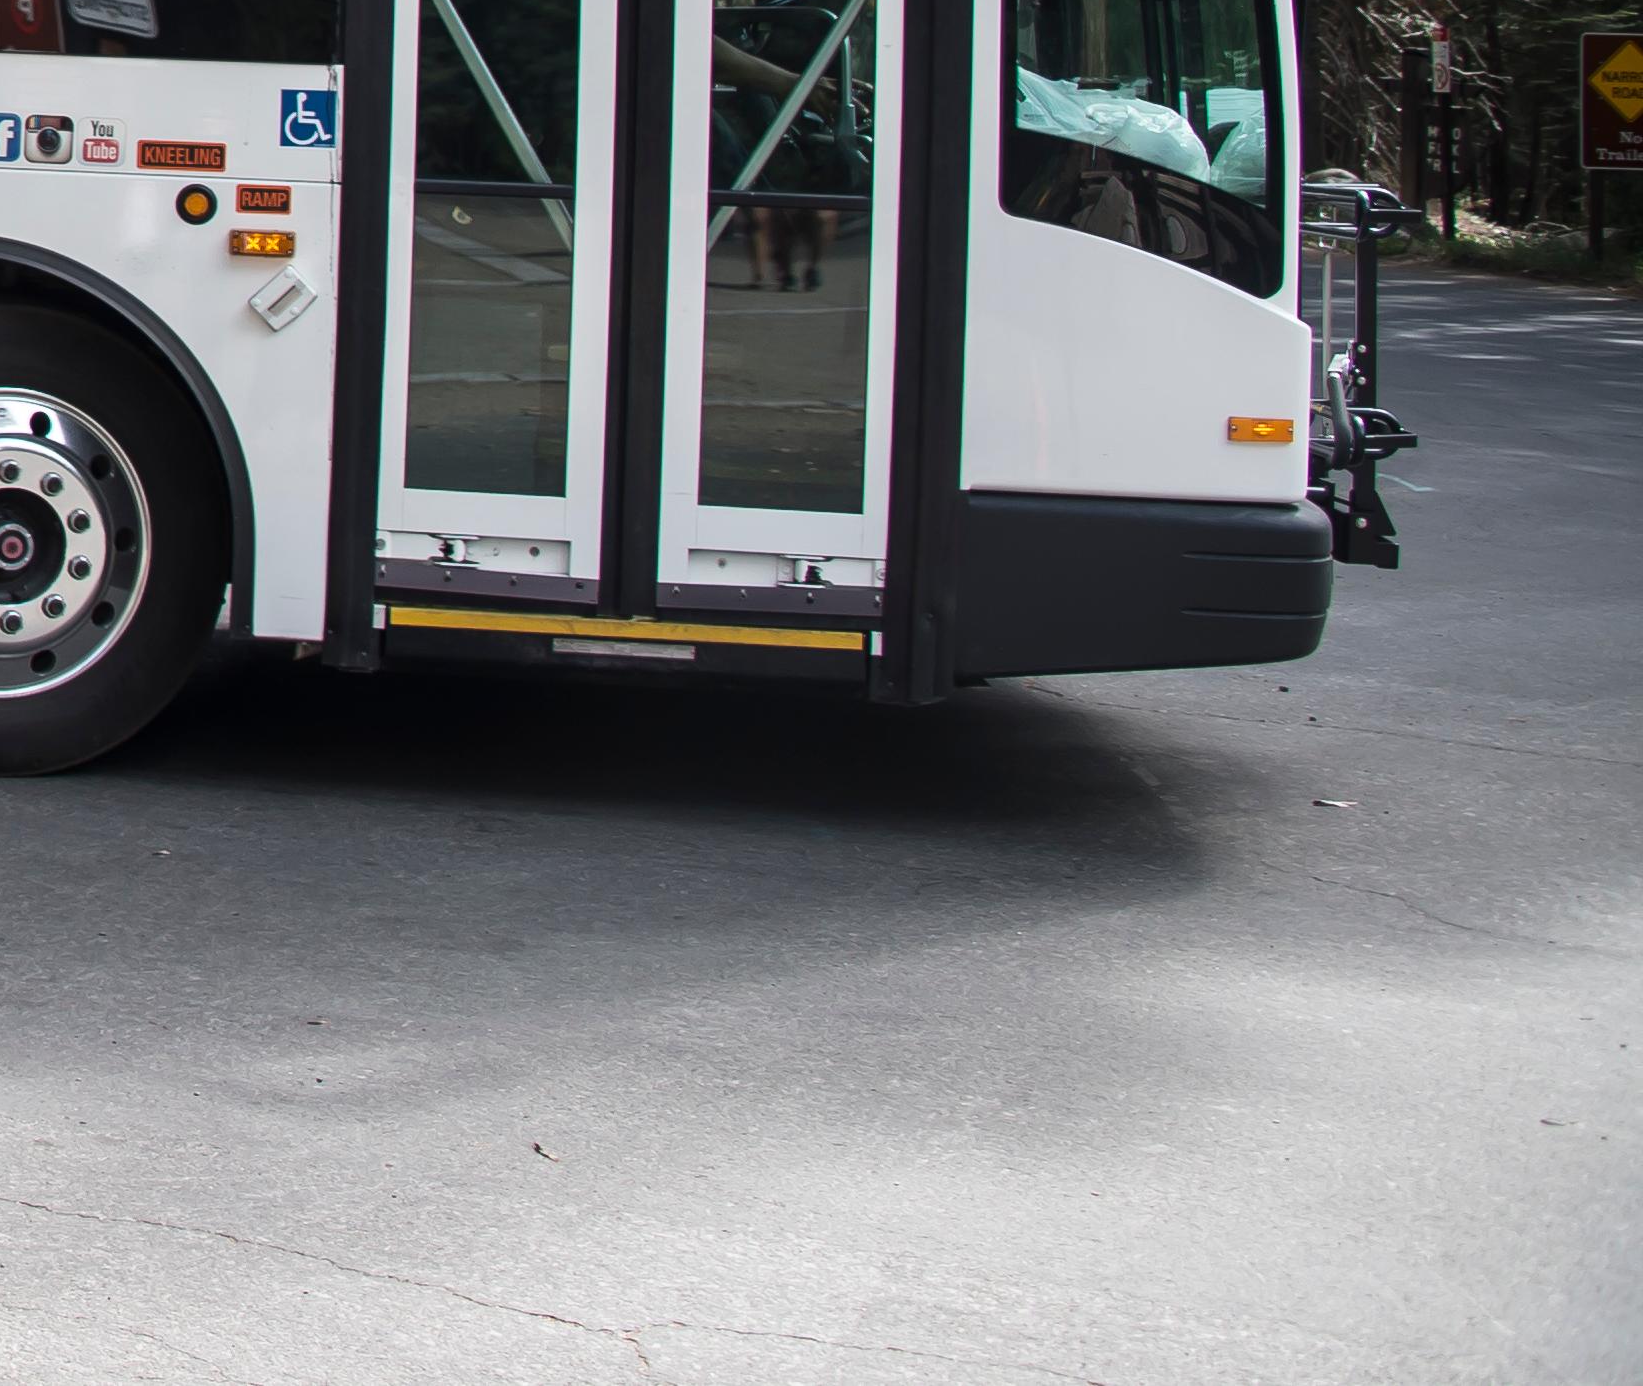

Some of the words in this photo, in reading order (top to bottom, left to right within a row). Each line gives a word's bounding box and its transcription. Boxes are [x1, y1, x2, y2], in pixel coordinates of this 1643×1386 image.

[90, 120, 114, 137] You
[1618, 131, 1643, 144] No
[85, 141, 117, 160] Tube
[143, 145, 222, 166] KNEELING
[241, 191, 288, 207] RAMP
